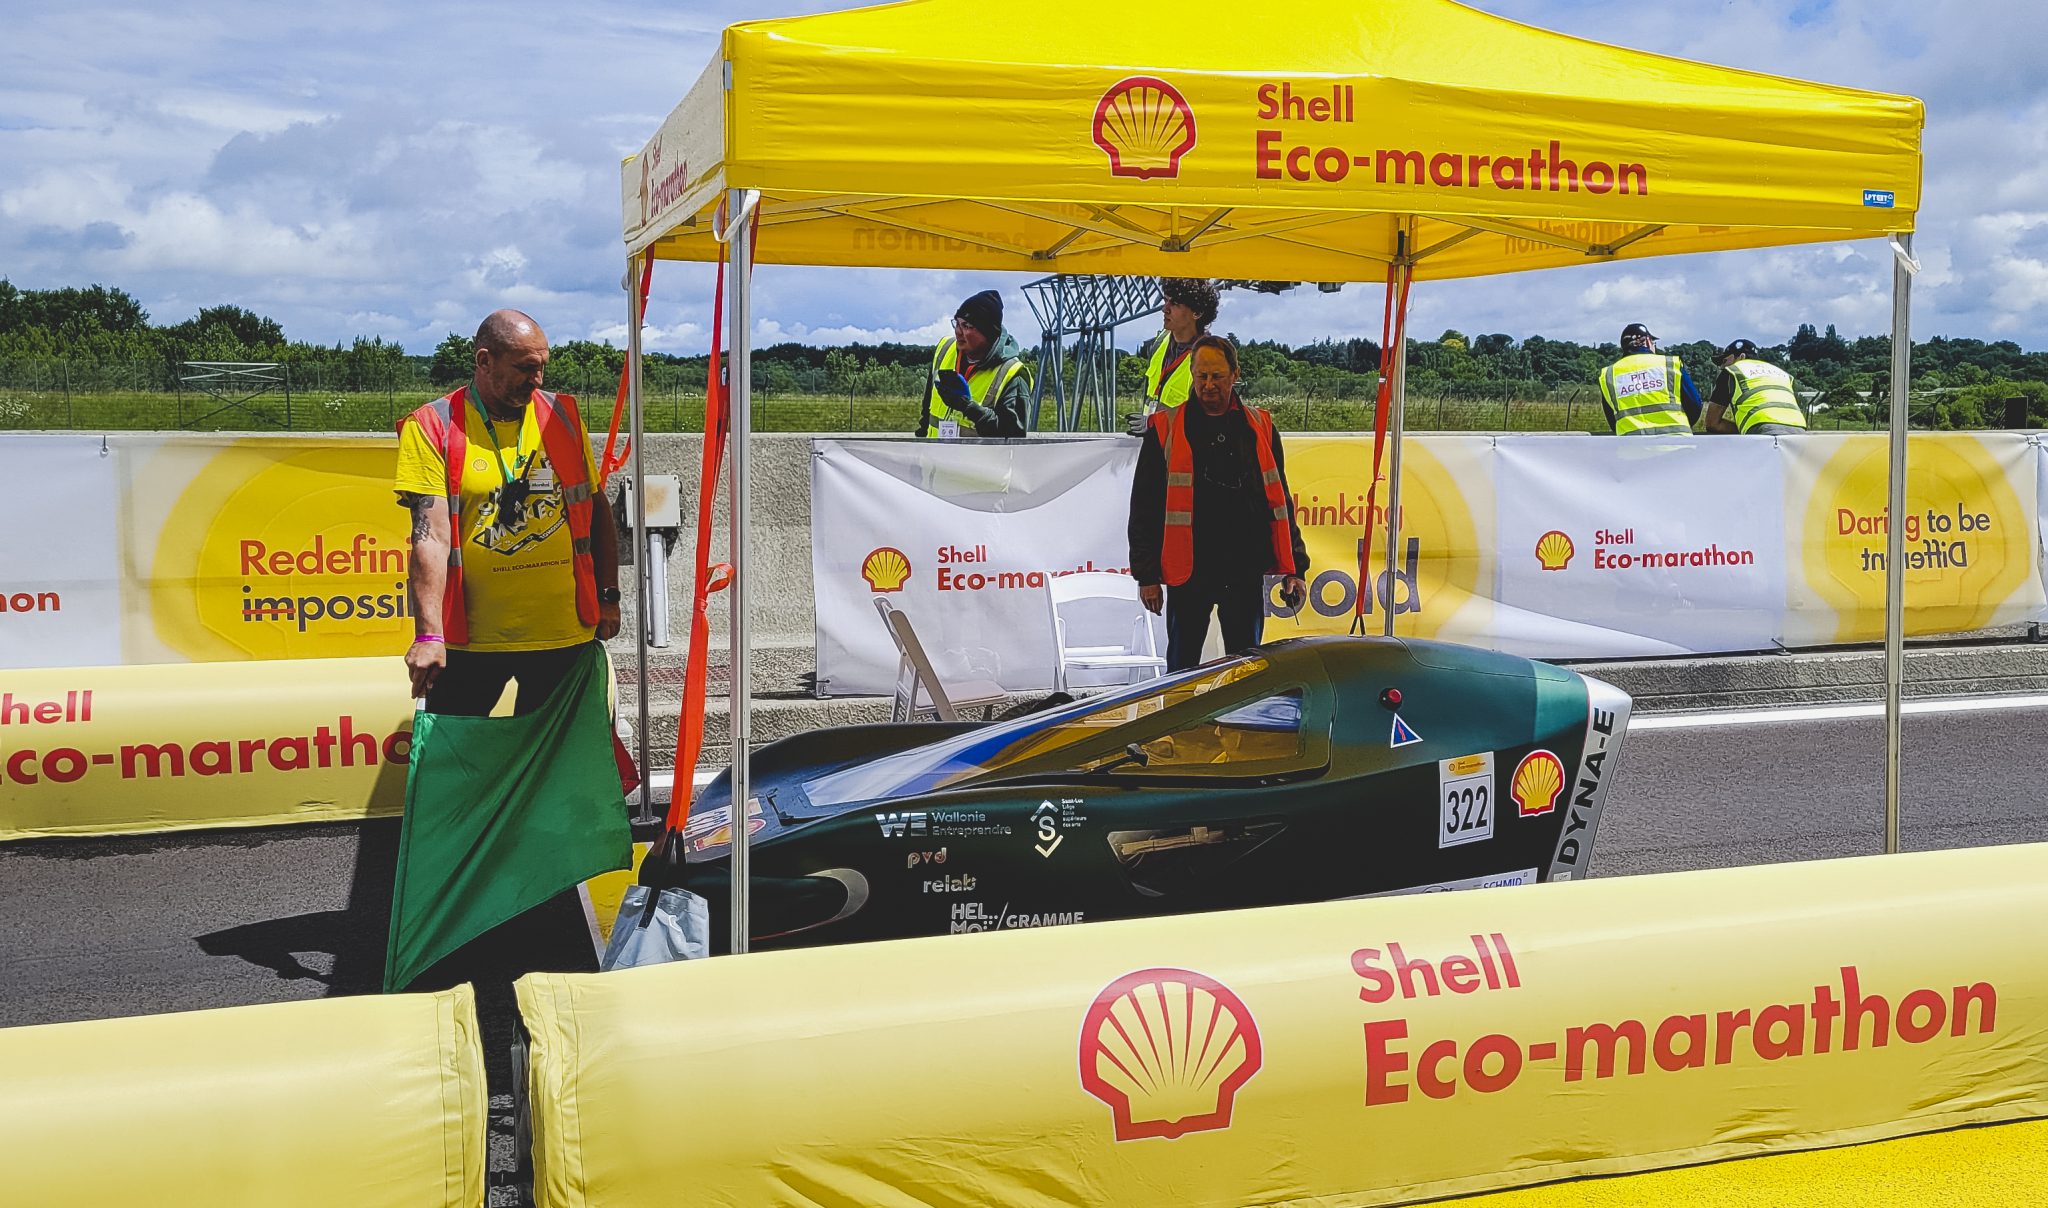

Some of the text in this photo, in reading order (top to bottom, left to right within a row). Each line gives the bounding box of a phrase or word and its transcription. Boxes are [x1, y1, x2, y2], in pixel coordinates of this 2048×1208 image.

[1257, 82, 1354, 122] Shell
[1256, 130, 1648, 196] Eco-marathon
[1620, 380, 1663, 395] ACCESS
[1631, 372, 1648, 382] PIT
[1594, 528, 1634, 545] Shell
[1837, 502, 1990, 542] Darig to be
[240, 533, 413, 576] Redefini
[937, 545, 986, 563] Shell
[1594, 543, 1754, 569] Eco-marathon
[242, 578, 415, 632] impossi
[0, 690, 92, 725] hell
[0, 715, 413, 785] co-maratho
[1556, 707, 1615, 866] DYNA-E
[875, 810, 986, 838] WE Wallonie
[1446, 785, 1489, 835] 322
[932, 823, 1012, 838] Entreprendre
[907, 847, 947, 869] pvd
[923, 873, 977, 893] relab
[1006, 911, 1084, 929] GRAMME
[1350, 932, 1522, 1004] Shell
[1363, 966, 1998, 1108] Eco-marathon
